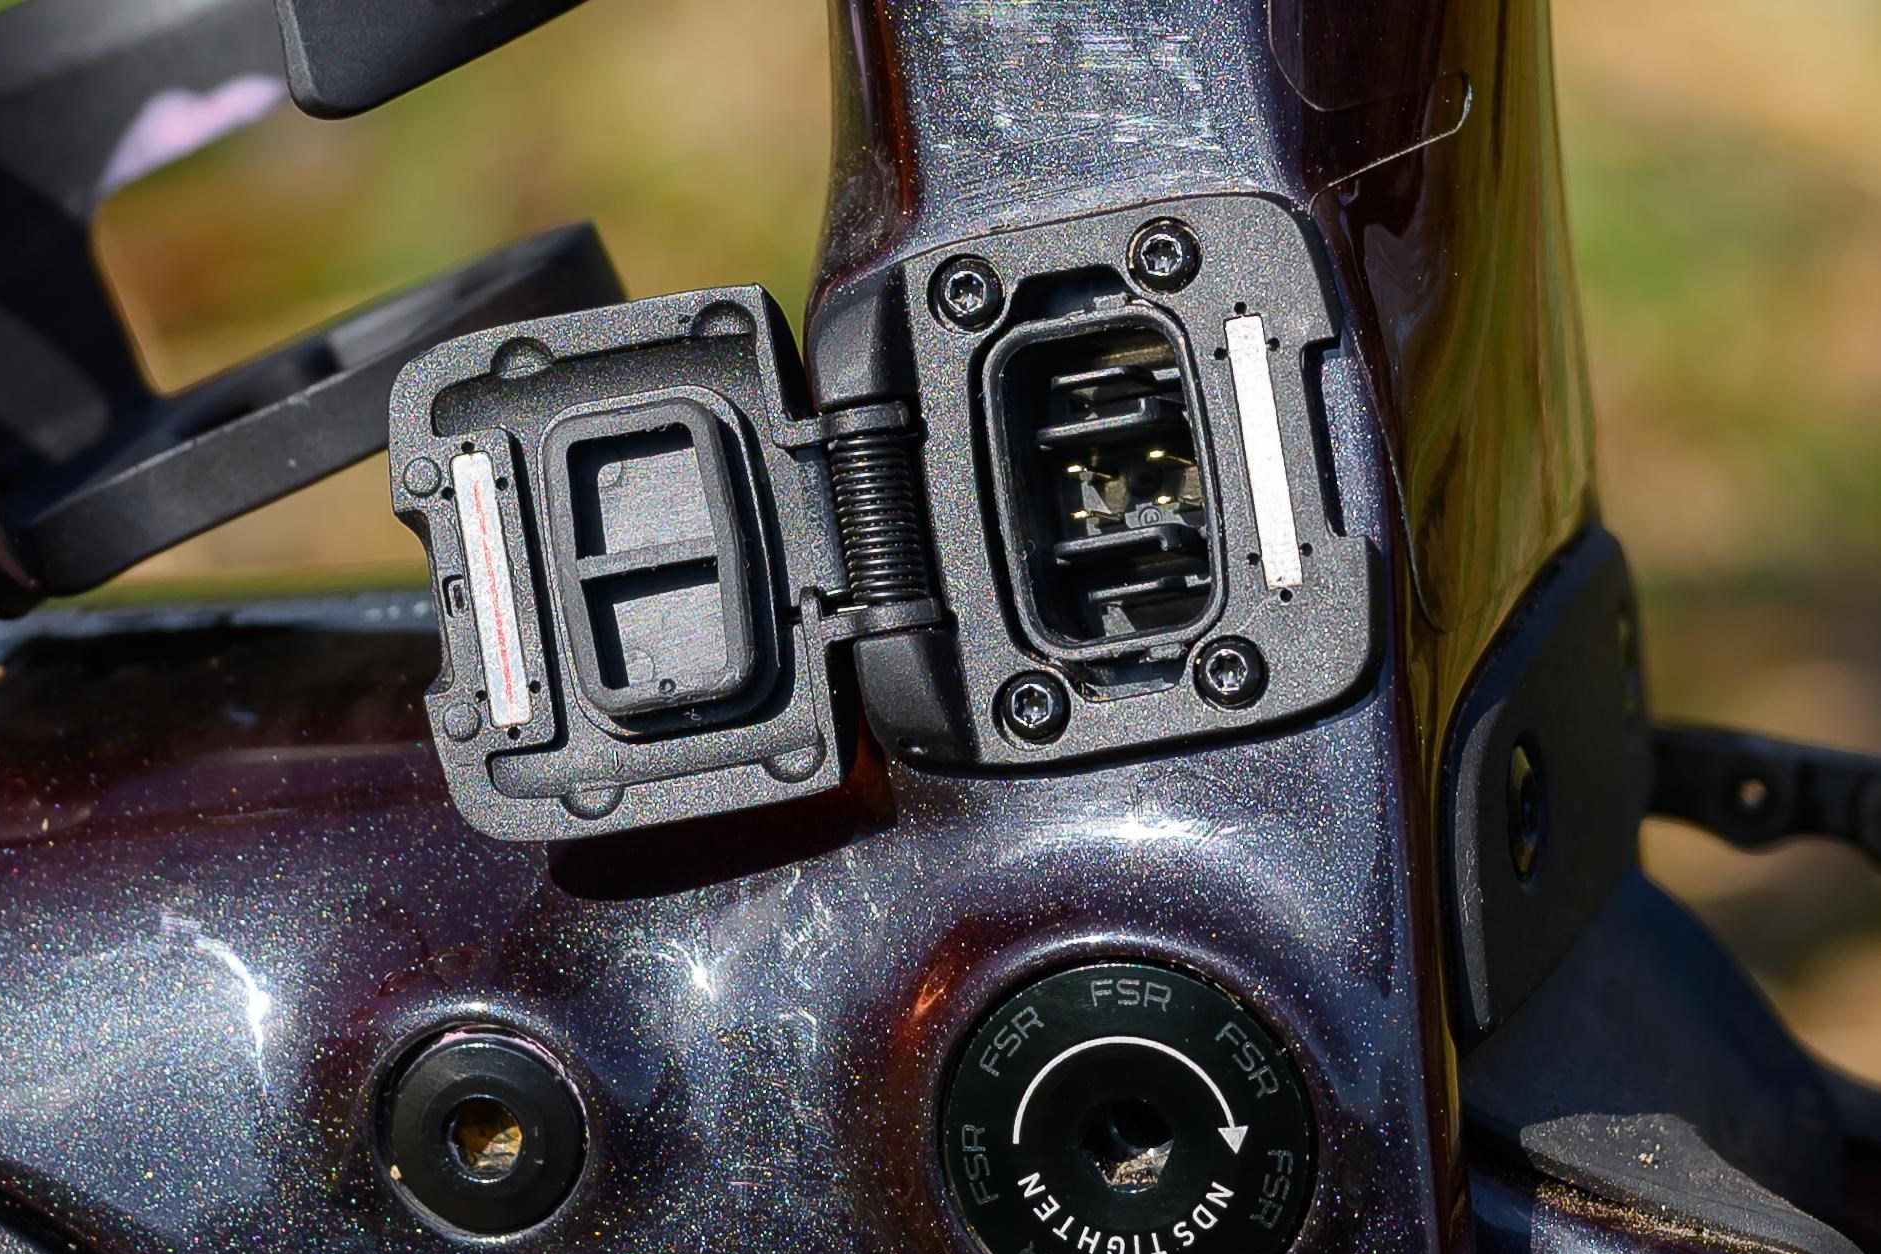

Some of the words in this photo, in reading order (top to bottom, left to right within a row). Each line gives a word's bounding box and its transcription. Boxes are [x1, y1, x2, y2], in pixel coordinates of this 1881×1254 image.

[1090, 979, 1172, 1012] FSR
[979, 1006, 1045, 1077] FSR
[1216, 1021, 1280, 1098] FSR
[961, 1124, 999, 1206] FSR
[1251, 1149, 1294, 1230] FSR
